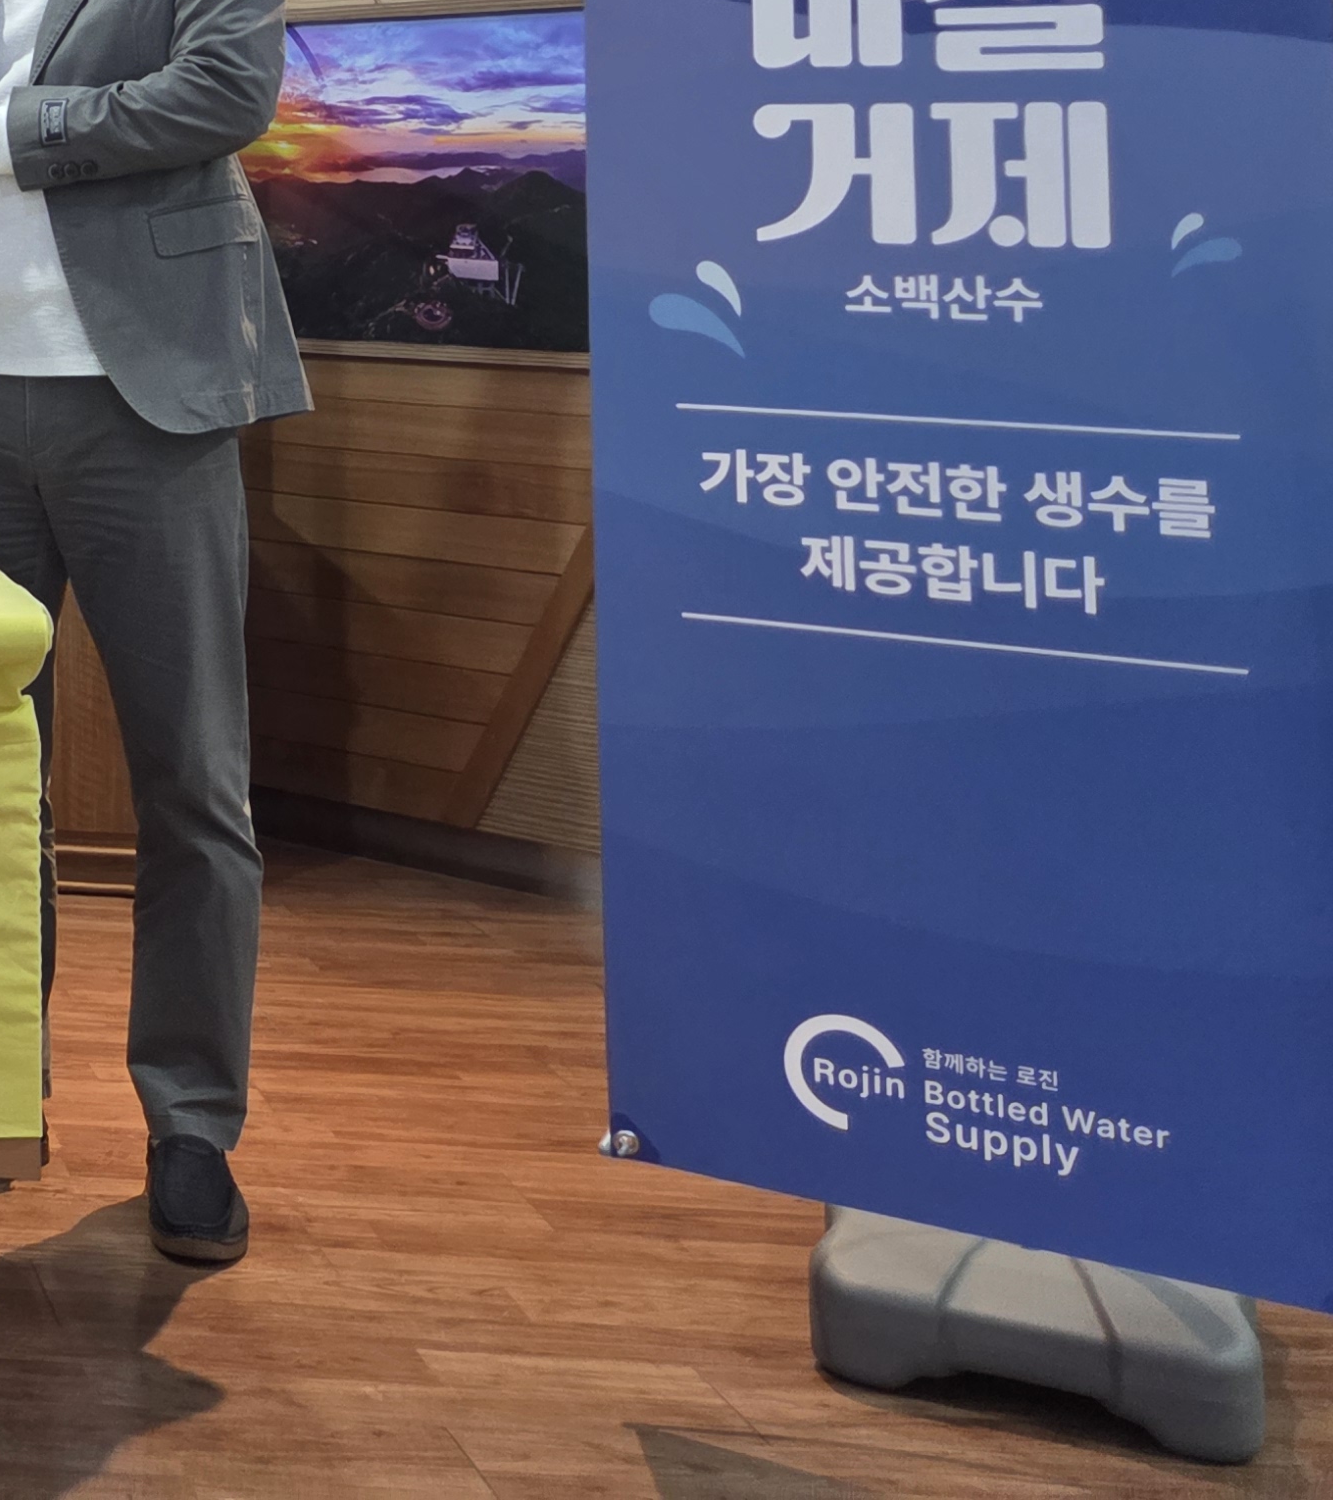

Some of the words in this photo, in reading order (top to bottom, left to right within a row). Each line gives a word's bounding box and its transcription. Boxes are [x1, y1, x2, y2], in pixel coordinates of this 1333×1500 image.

[752, 100, 1111, 250] 거제
[844, 273, 1043, 323] 소백산수
[700, 448, 811, 507] 가장
[826, 457, 1007, 523] 안전한
[1023, 471, 1216, 539] 생수를
[800, 534, 1105, 616] 제공합니다
[813, 1056, 906, 1100] Rojin
[923, 1079, 1049, 1128] Bottled
[1061, 1104, 1171, 1150] Water
[921, 1047, 1009, 1082] 함께하는
[1016, 1064, 1060, 1093] 로진
[925, 1111, 1080, 1177] Supply
